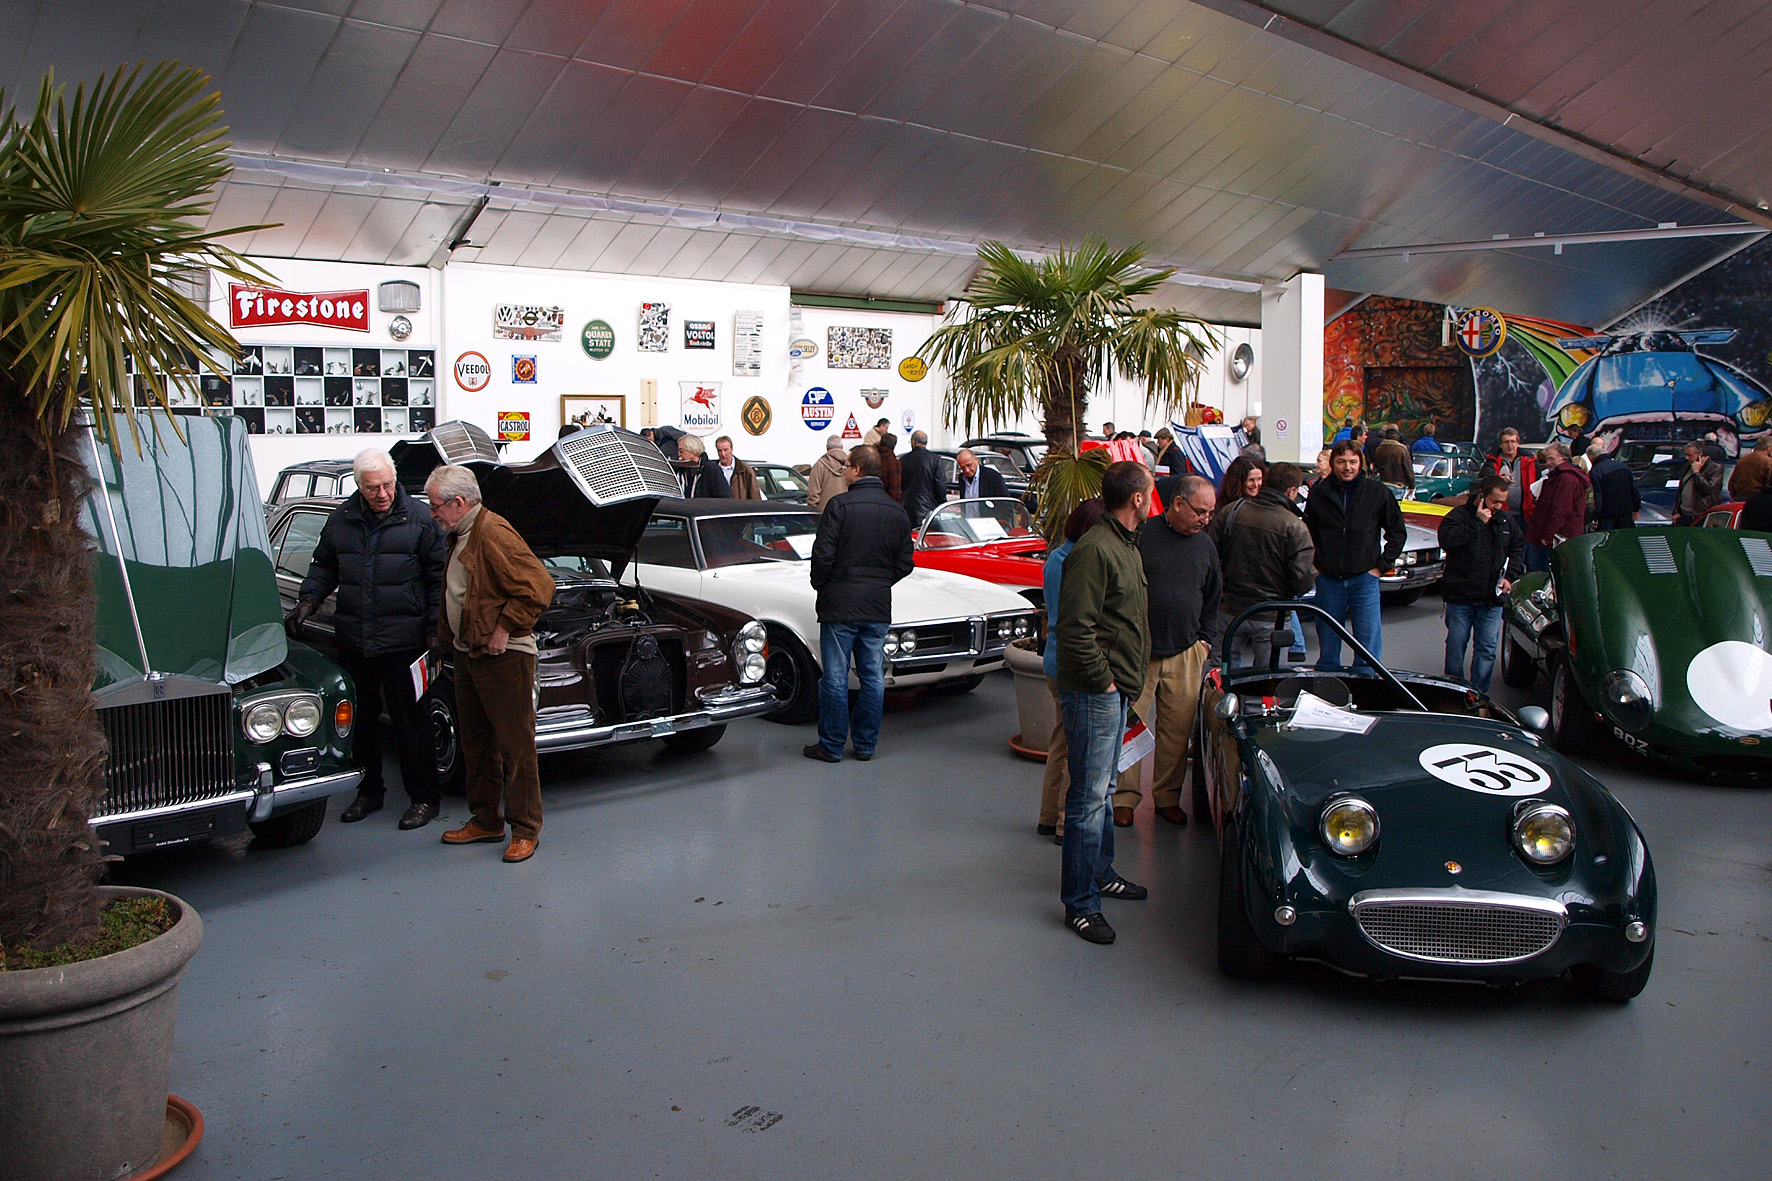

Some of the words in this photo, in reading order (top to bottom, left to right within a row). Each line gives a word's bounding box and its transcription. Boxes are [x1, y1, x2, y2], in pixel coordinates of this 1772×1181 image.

[236, 290, 364, 320] Firestone
[585, 331, 612, 339] QUAKER
[686, 330, 714, 340] VOLTOL
[588, 339, 612, 347] STATE
[457, 363, 489, 378] VEEDOL
[803, 407, 834, 418] AUSTIN
[684, 414, 719, 425] Mobiloil
[500, 421, 529, 432] CASTROL
[1432, 750, 1541, 791] 33
